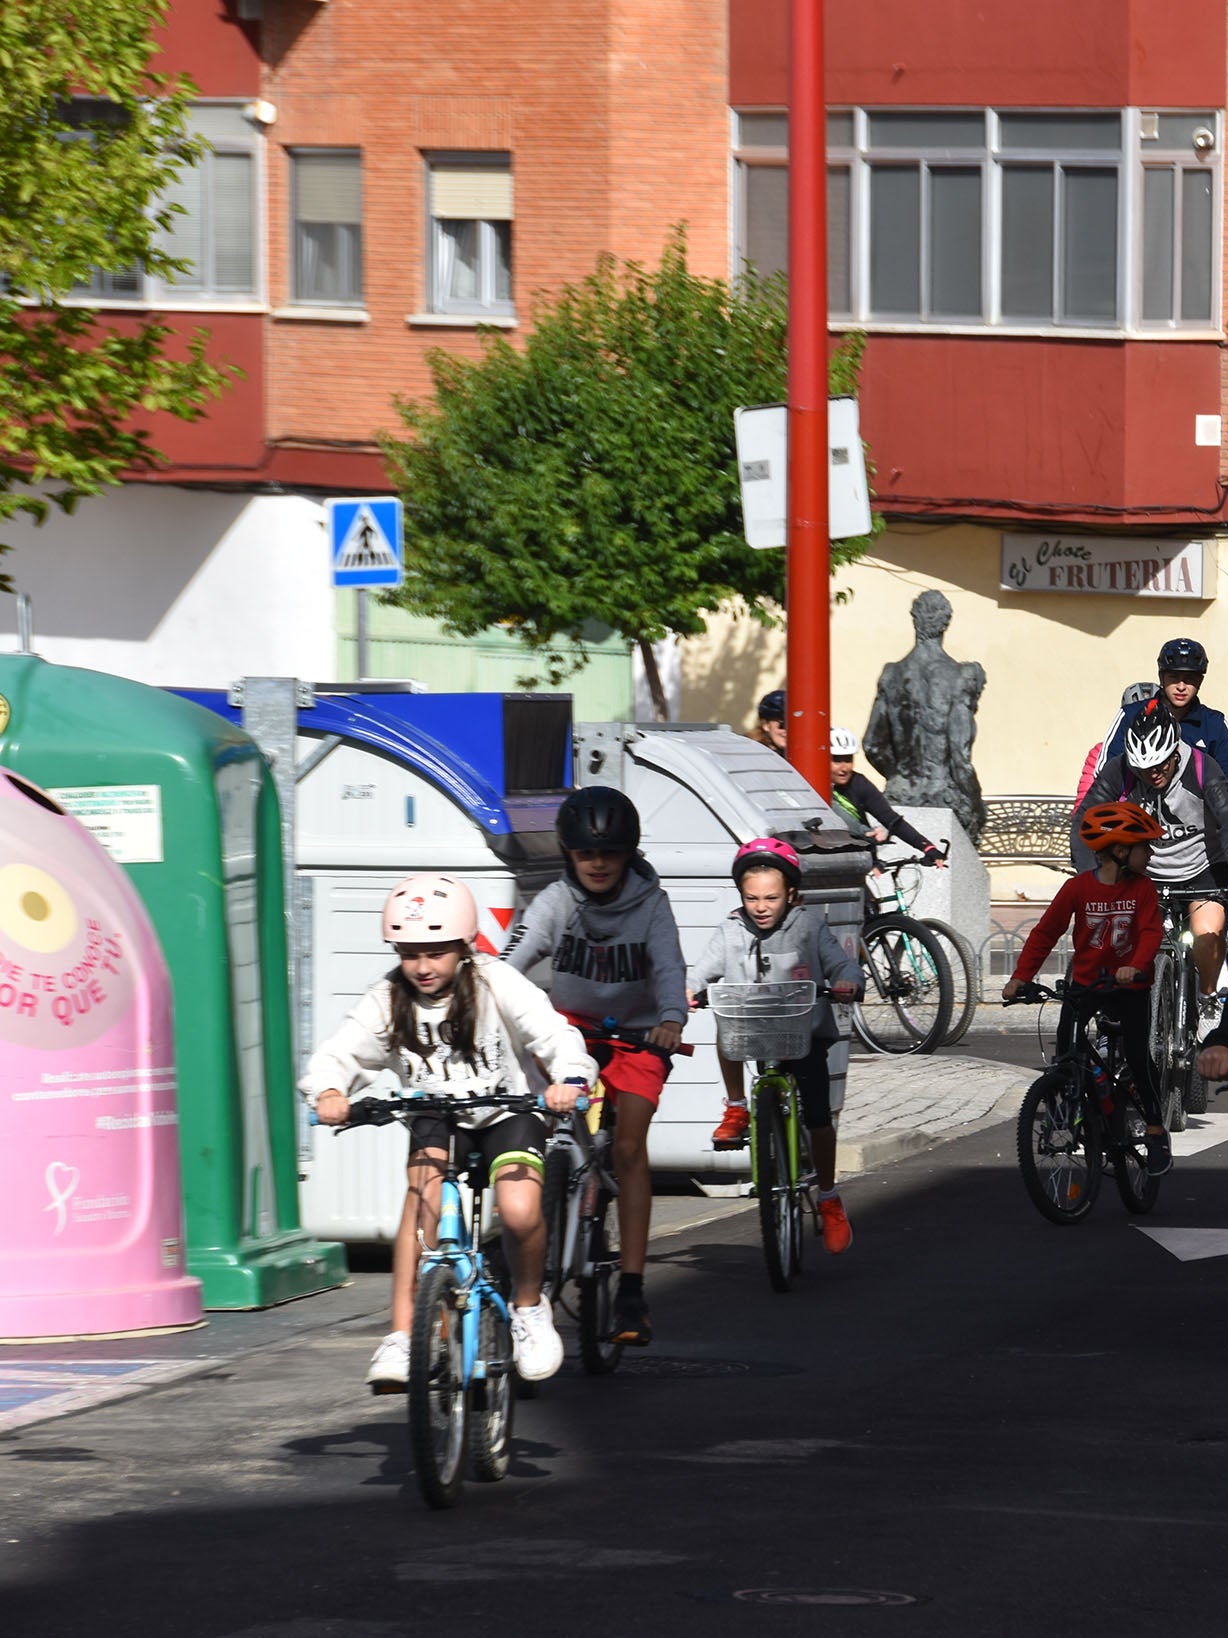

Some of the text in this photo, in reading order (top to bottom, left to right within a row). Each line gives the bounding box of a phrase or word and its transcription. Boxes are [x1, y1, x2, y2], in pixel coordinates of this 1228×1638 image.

[1009, 557, 1032, 586] El
[1085, 900, 1136, 912] ATHLETICS
[30, 973, 57, 992] TE
[61, 918, 102, 990] CONOCE
[52, 978, 107, 1026] QUE
